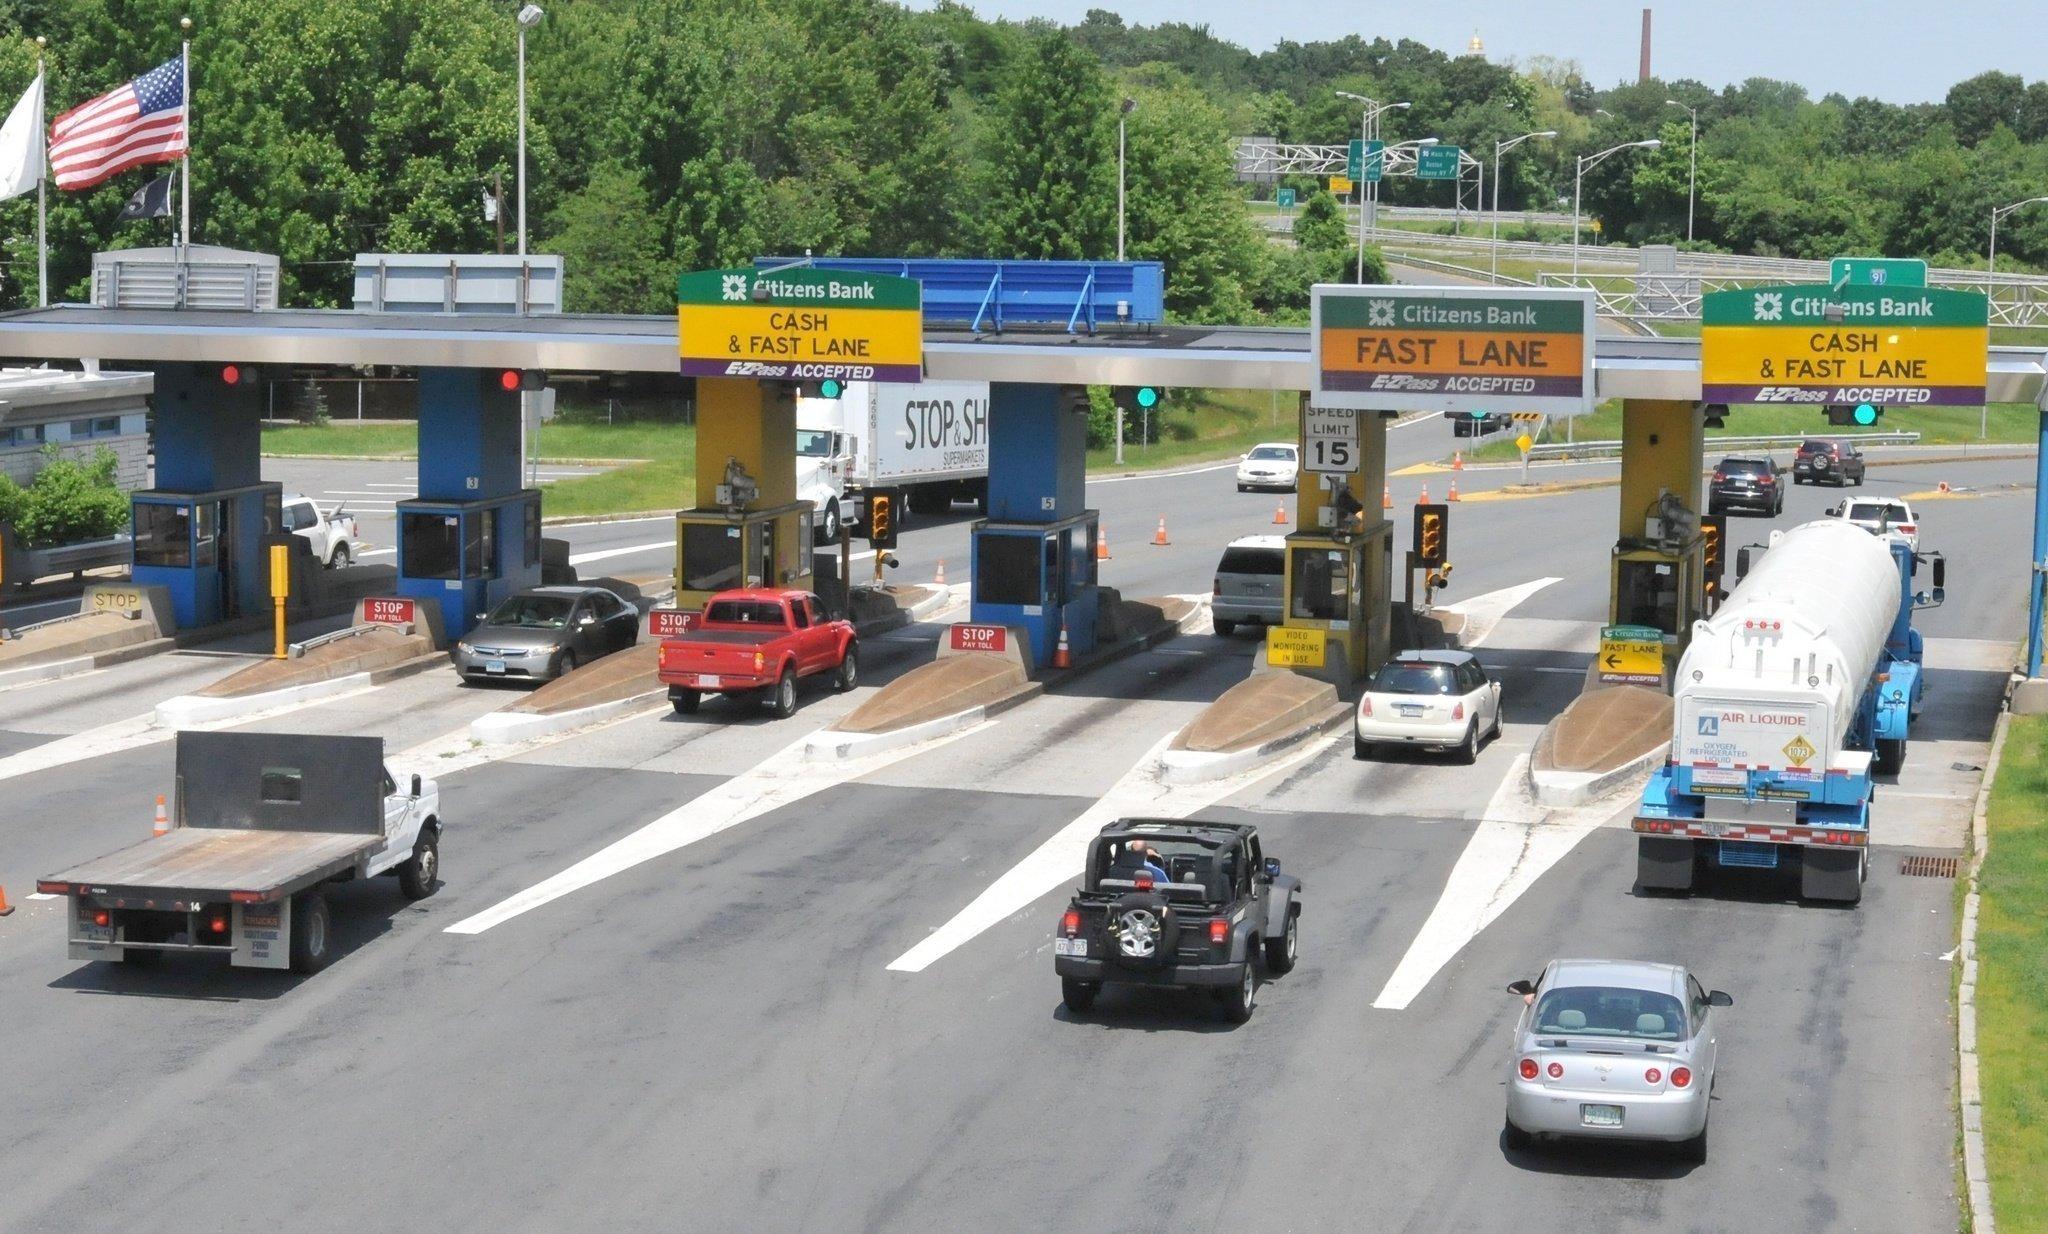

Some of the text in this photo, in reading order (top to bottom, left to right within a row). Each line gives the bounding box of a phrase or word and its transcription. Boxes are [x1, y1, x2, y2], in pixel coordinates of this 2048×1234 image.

[1872, 272, 1883, 283] 91
[829, 281, 874, 299] Bank
[1790, 297, 1934, 317] Citiens Bank
[1403, 305, 1536, 325] Citizens Bank
[770, 312, 828, 331] CASH
[728, 335, 870, 357] & FAST LANE
[1809, 333, 1878, 352] CASH
[1357, 337, 1549, 368] FAST LANE
[791, 364, 875, 379] ACCEPTED
[1760, 358, 1927, 379] & FAST LANE
[1444, 376, 1536, 393] ACCEPTED
[1833, 388, 1931, 402] ACCEPTED
[1308, 406, 1354, 418] SPEED
[905, 398, 990, 450] STOP & SH
[1313, 424, 1350, 435] LIMIT
[943, 448, 985, 466] SUPERMARKETS
[1315, 440, 1349, 466] 15
[470, 478, 476, 488] 3
[1045, 498, 1052, 508] 5
[95, 592, 138, 608] STOP
[374, 601, 404, 614] STOP
[373, 613, 403, 622] PAY TOLL
[660, 614, 691, 626] STOP
[660, 626, 674, 634] PAY
[962, 628, 995, 641] STOP
[1286, 631, 1308, 640] VIDEO
[962, 641, 994, 650] PAY TOLL
[1273, 642, 1319, 652] MONITORING
[1604, 643, 1657, 654] FAST LANE
[1282, 654, 1309, 664] IN USE
[1720, 712, 1807, 726] AIR LIQUIDE
[1703, 742, 1737, 750] OXYGEN
[1790, 747, 1808, 757] 1073
[1689, 748, 1748, 758] REFRIGERATED
[1704, 756, 1732, 764] LIQUID
[190, 901, 201, 912] 14
